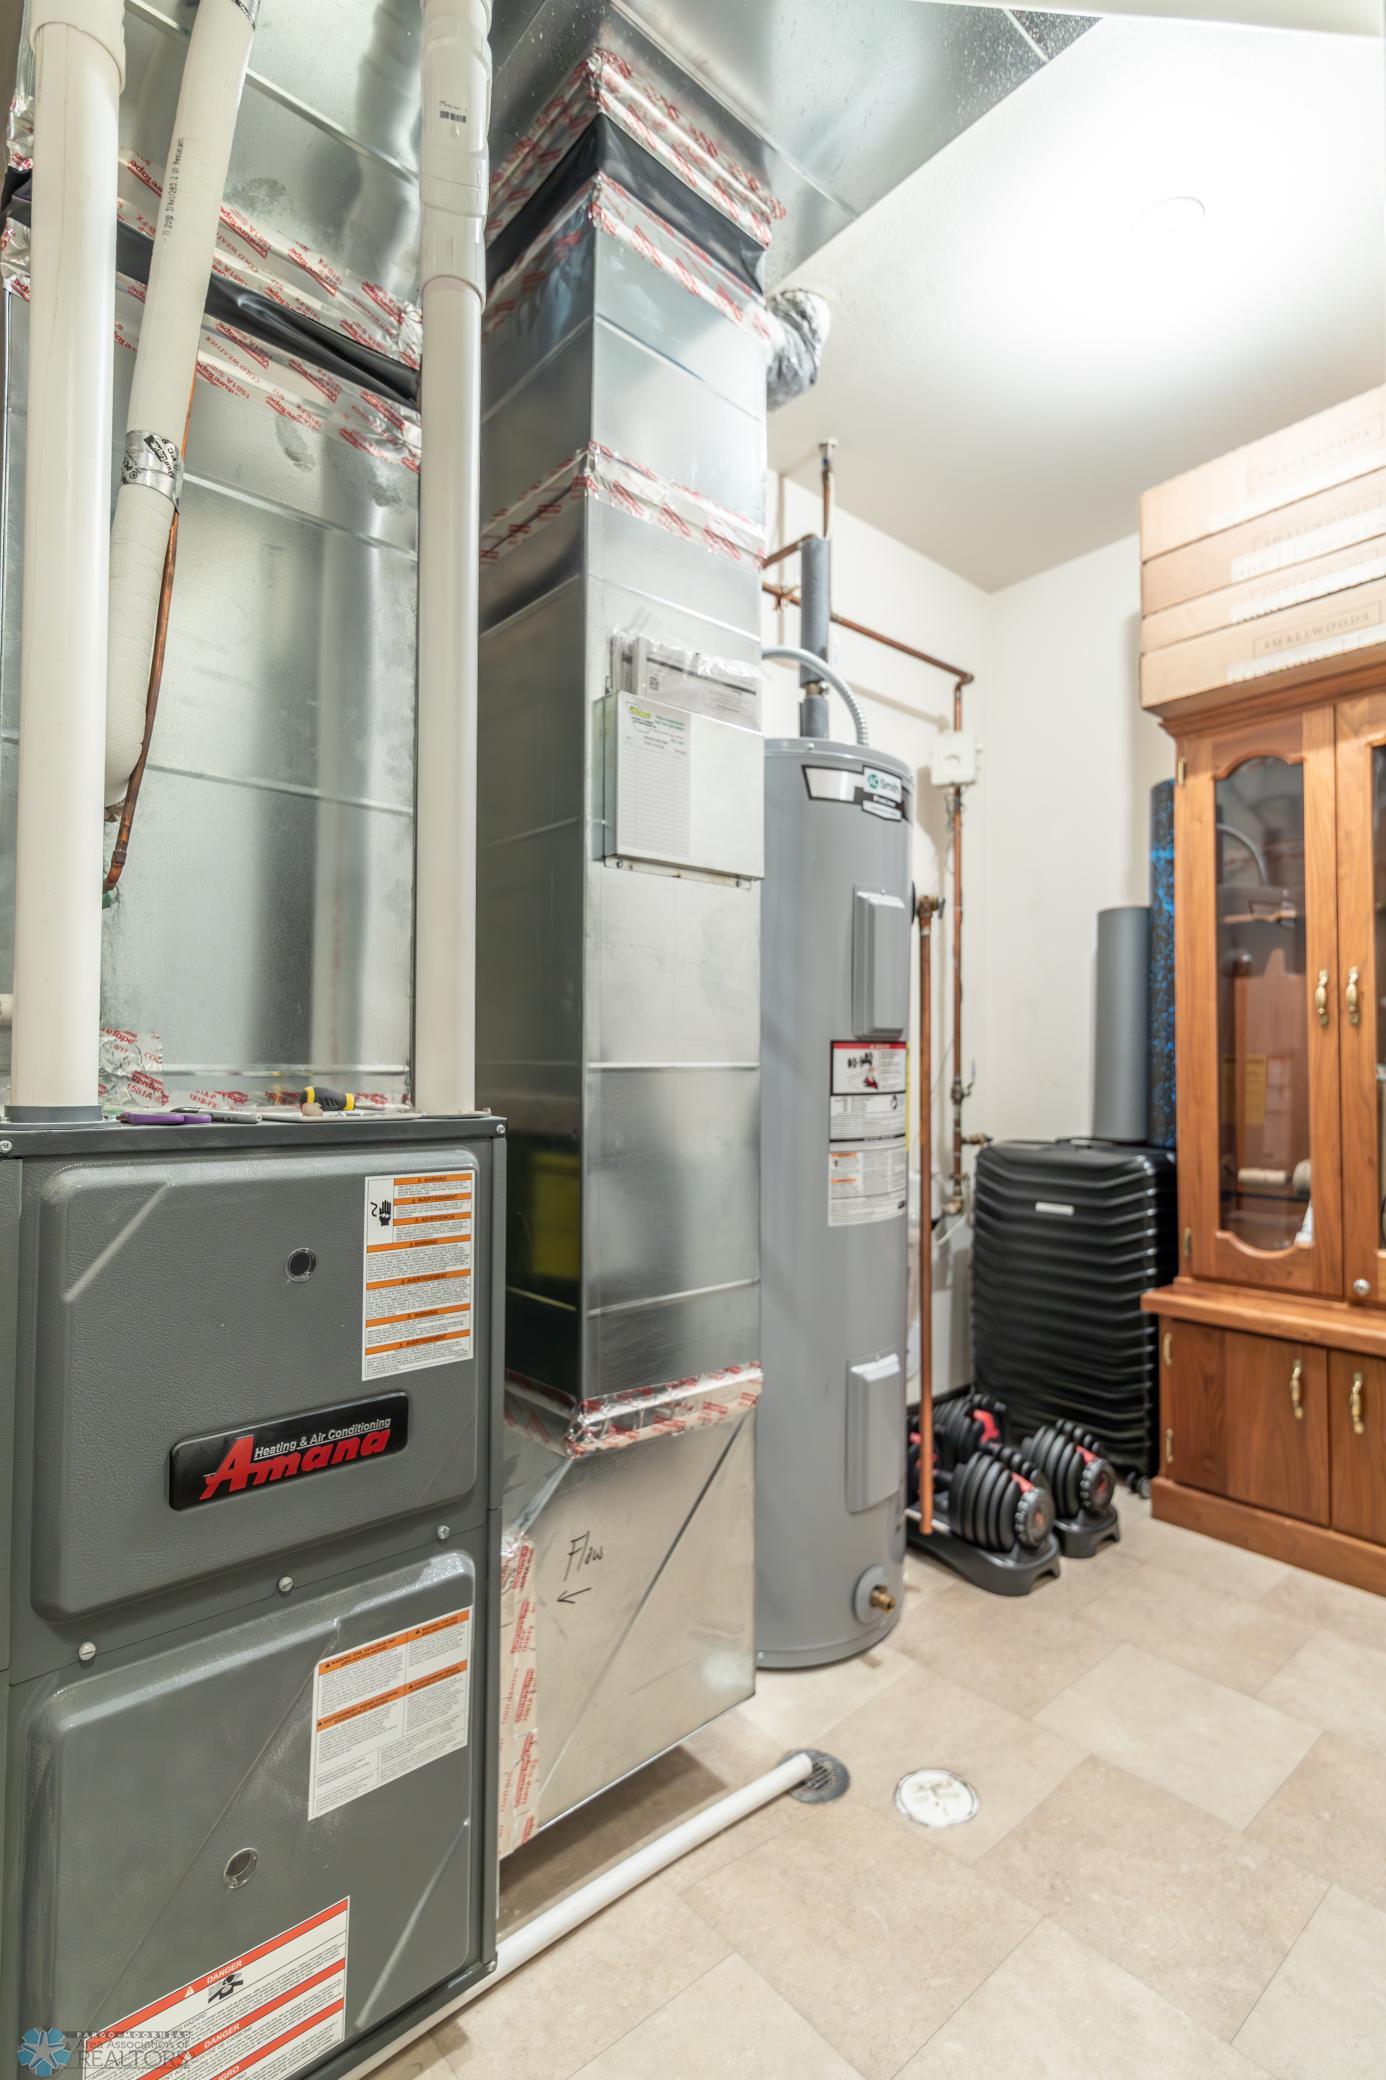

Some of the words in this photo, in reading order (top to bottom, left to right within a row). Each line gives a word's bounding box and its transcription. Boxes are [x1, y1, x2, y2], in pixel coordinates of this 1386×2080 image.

[254, 1440, 297, 1458] Heating
[300, 1437, 307, 1447] &
[309, 1432, 327, 1444] Air
[328, 1418, 392, 1439] Conditioning
[198, 1428, 392, 1501] Amana
[563, 1530, 604, 1581] Flow
[206, 1959, 243, 1985] DANGER
[204, 2023, 240, 2049] DANGER
